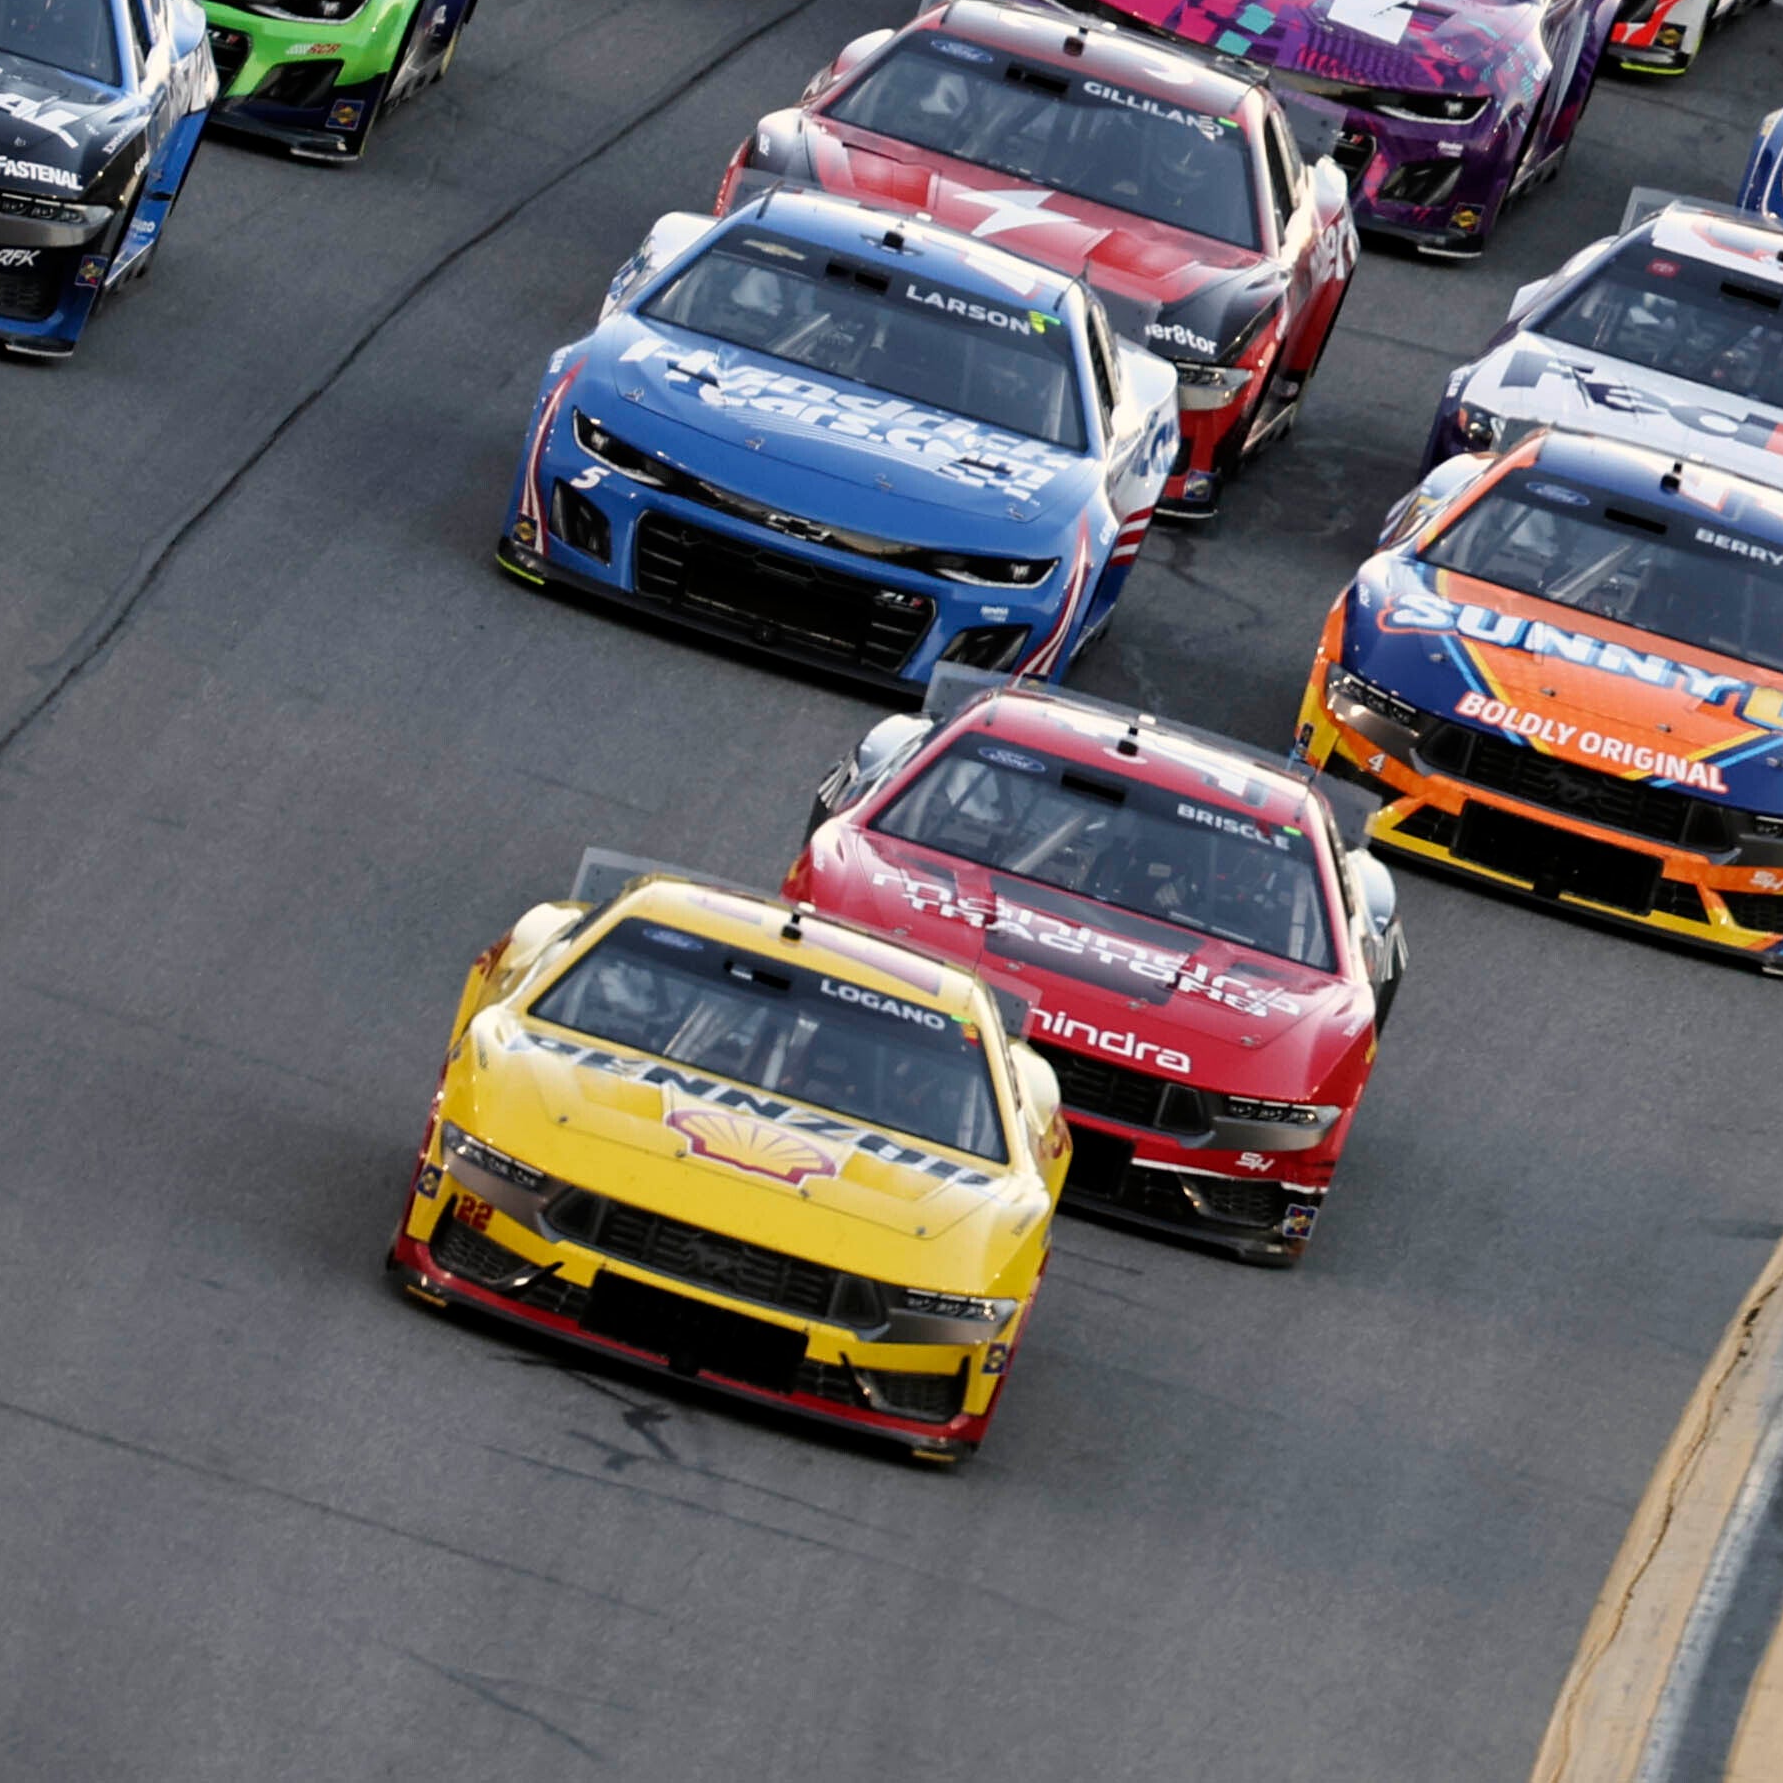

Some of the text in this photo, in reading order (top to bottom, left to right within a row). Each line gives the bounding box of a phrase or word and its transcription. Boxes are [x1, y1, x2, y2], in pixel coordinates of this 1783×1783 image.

[905, 283, 1031, 336] LARSON
[569, 466, 611, 489] 5
[1368, 753, 1387, 773] 4
[1454, 691, 1730, 795] BOLDLY ORIGINAL
[819, 977, 946, 1031] LOGANO
[455, 1192, 495, 1232] 22
